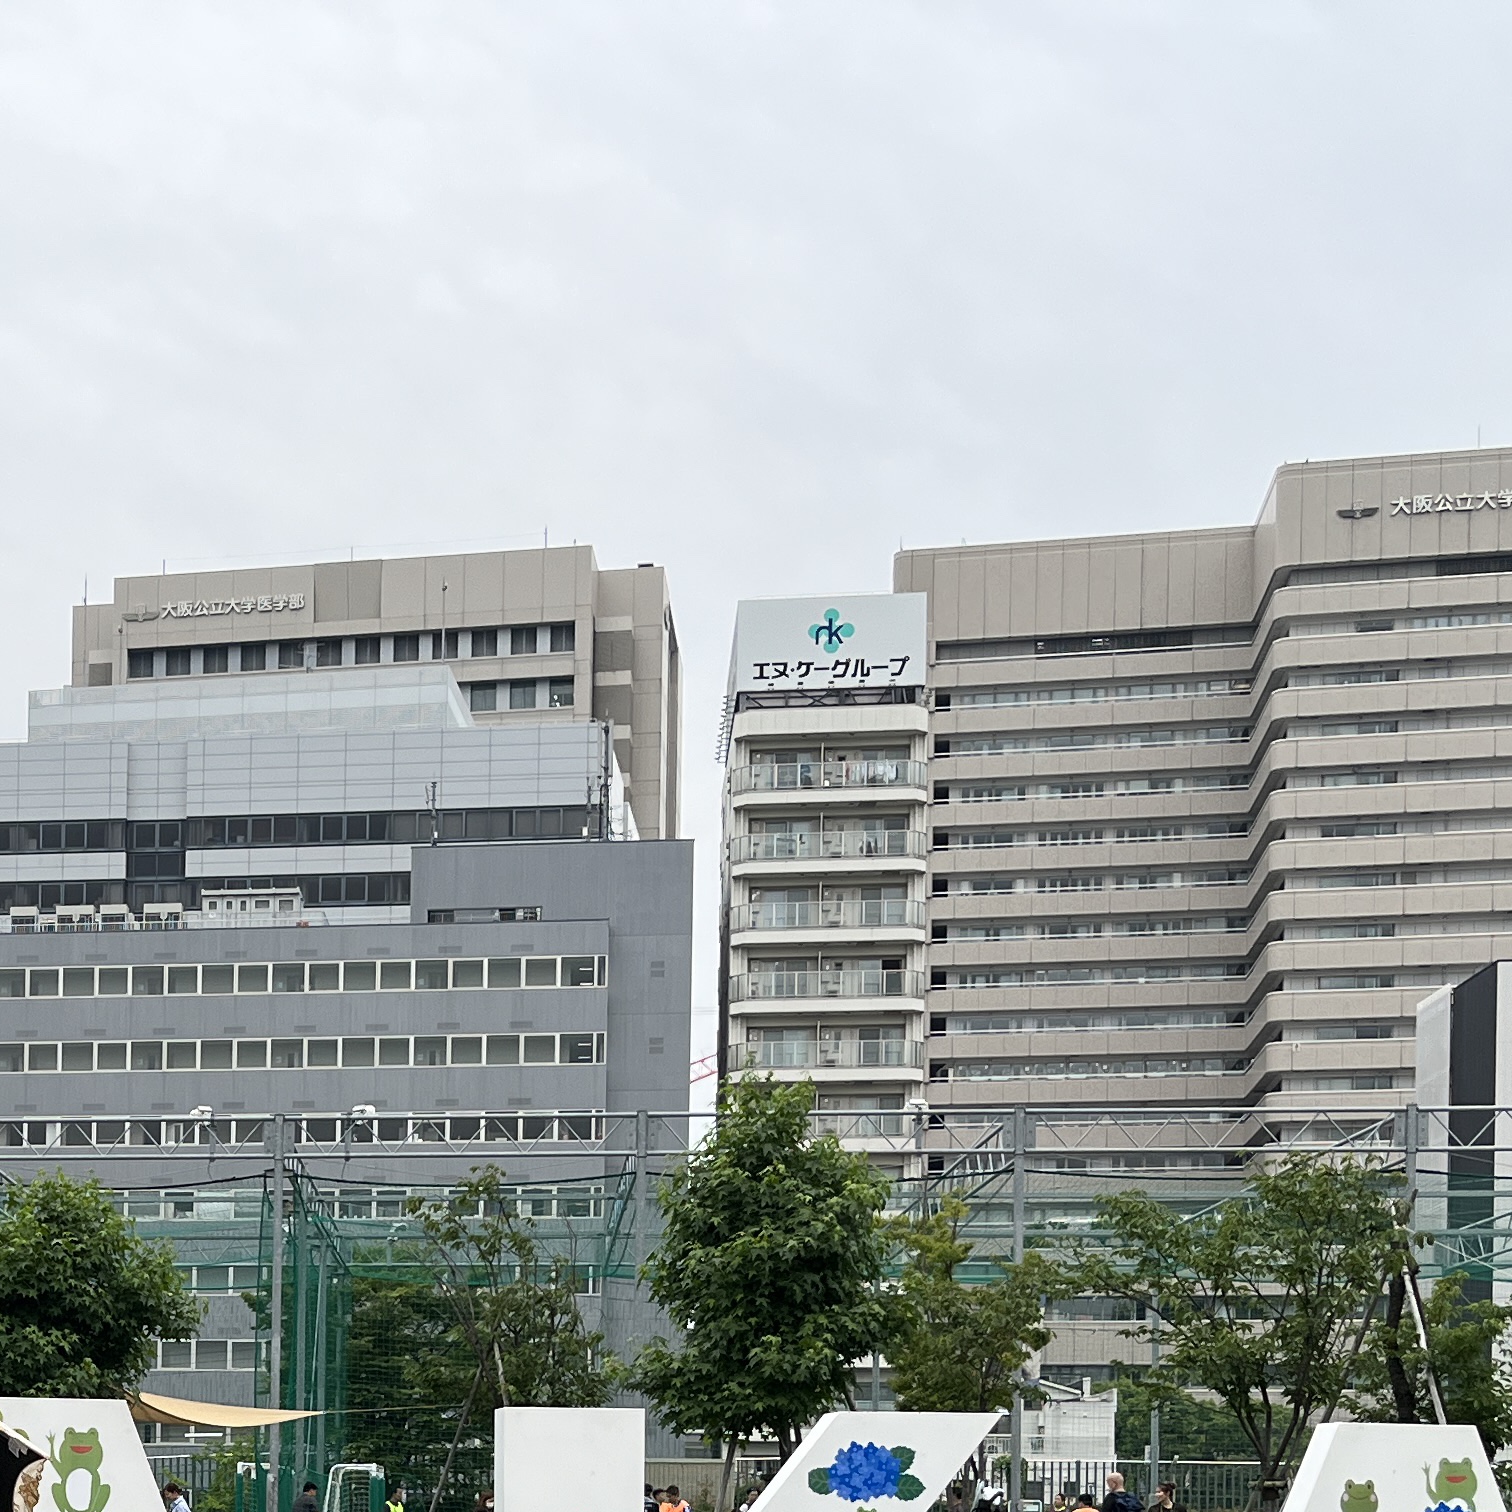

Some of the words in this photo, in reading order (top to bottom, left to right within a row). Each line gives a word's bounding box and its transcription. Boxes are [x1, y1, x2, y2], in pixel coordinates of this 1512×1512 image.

[1390, 488, 1512, 517] 大阪公立大学
[161, 593, 305, 619] 大阪公立大学医学部
[753, 655, 910, 680] エヌ・ケーグループ
